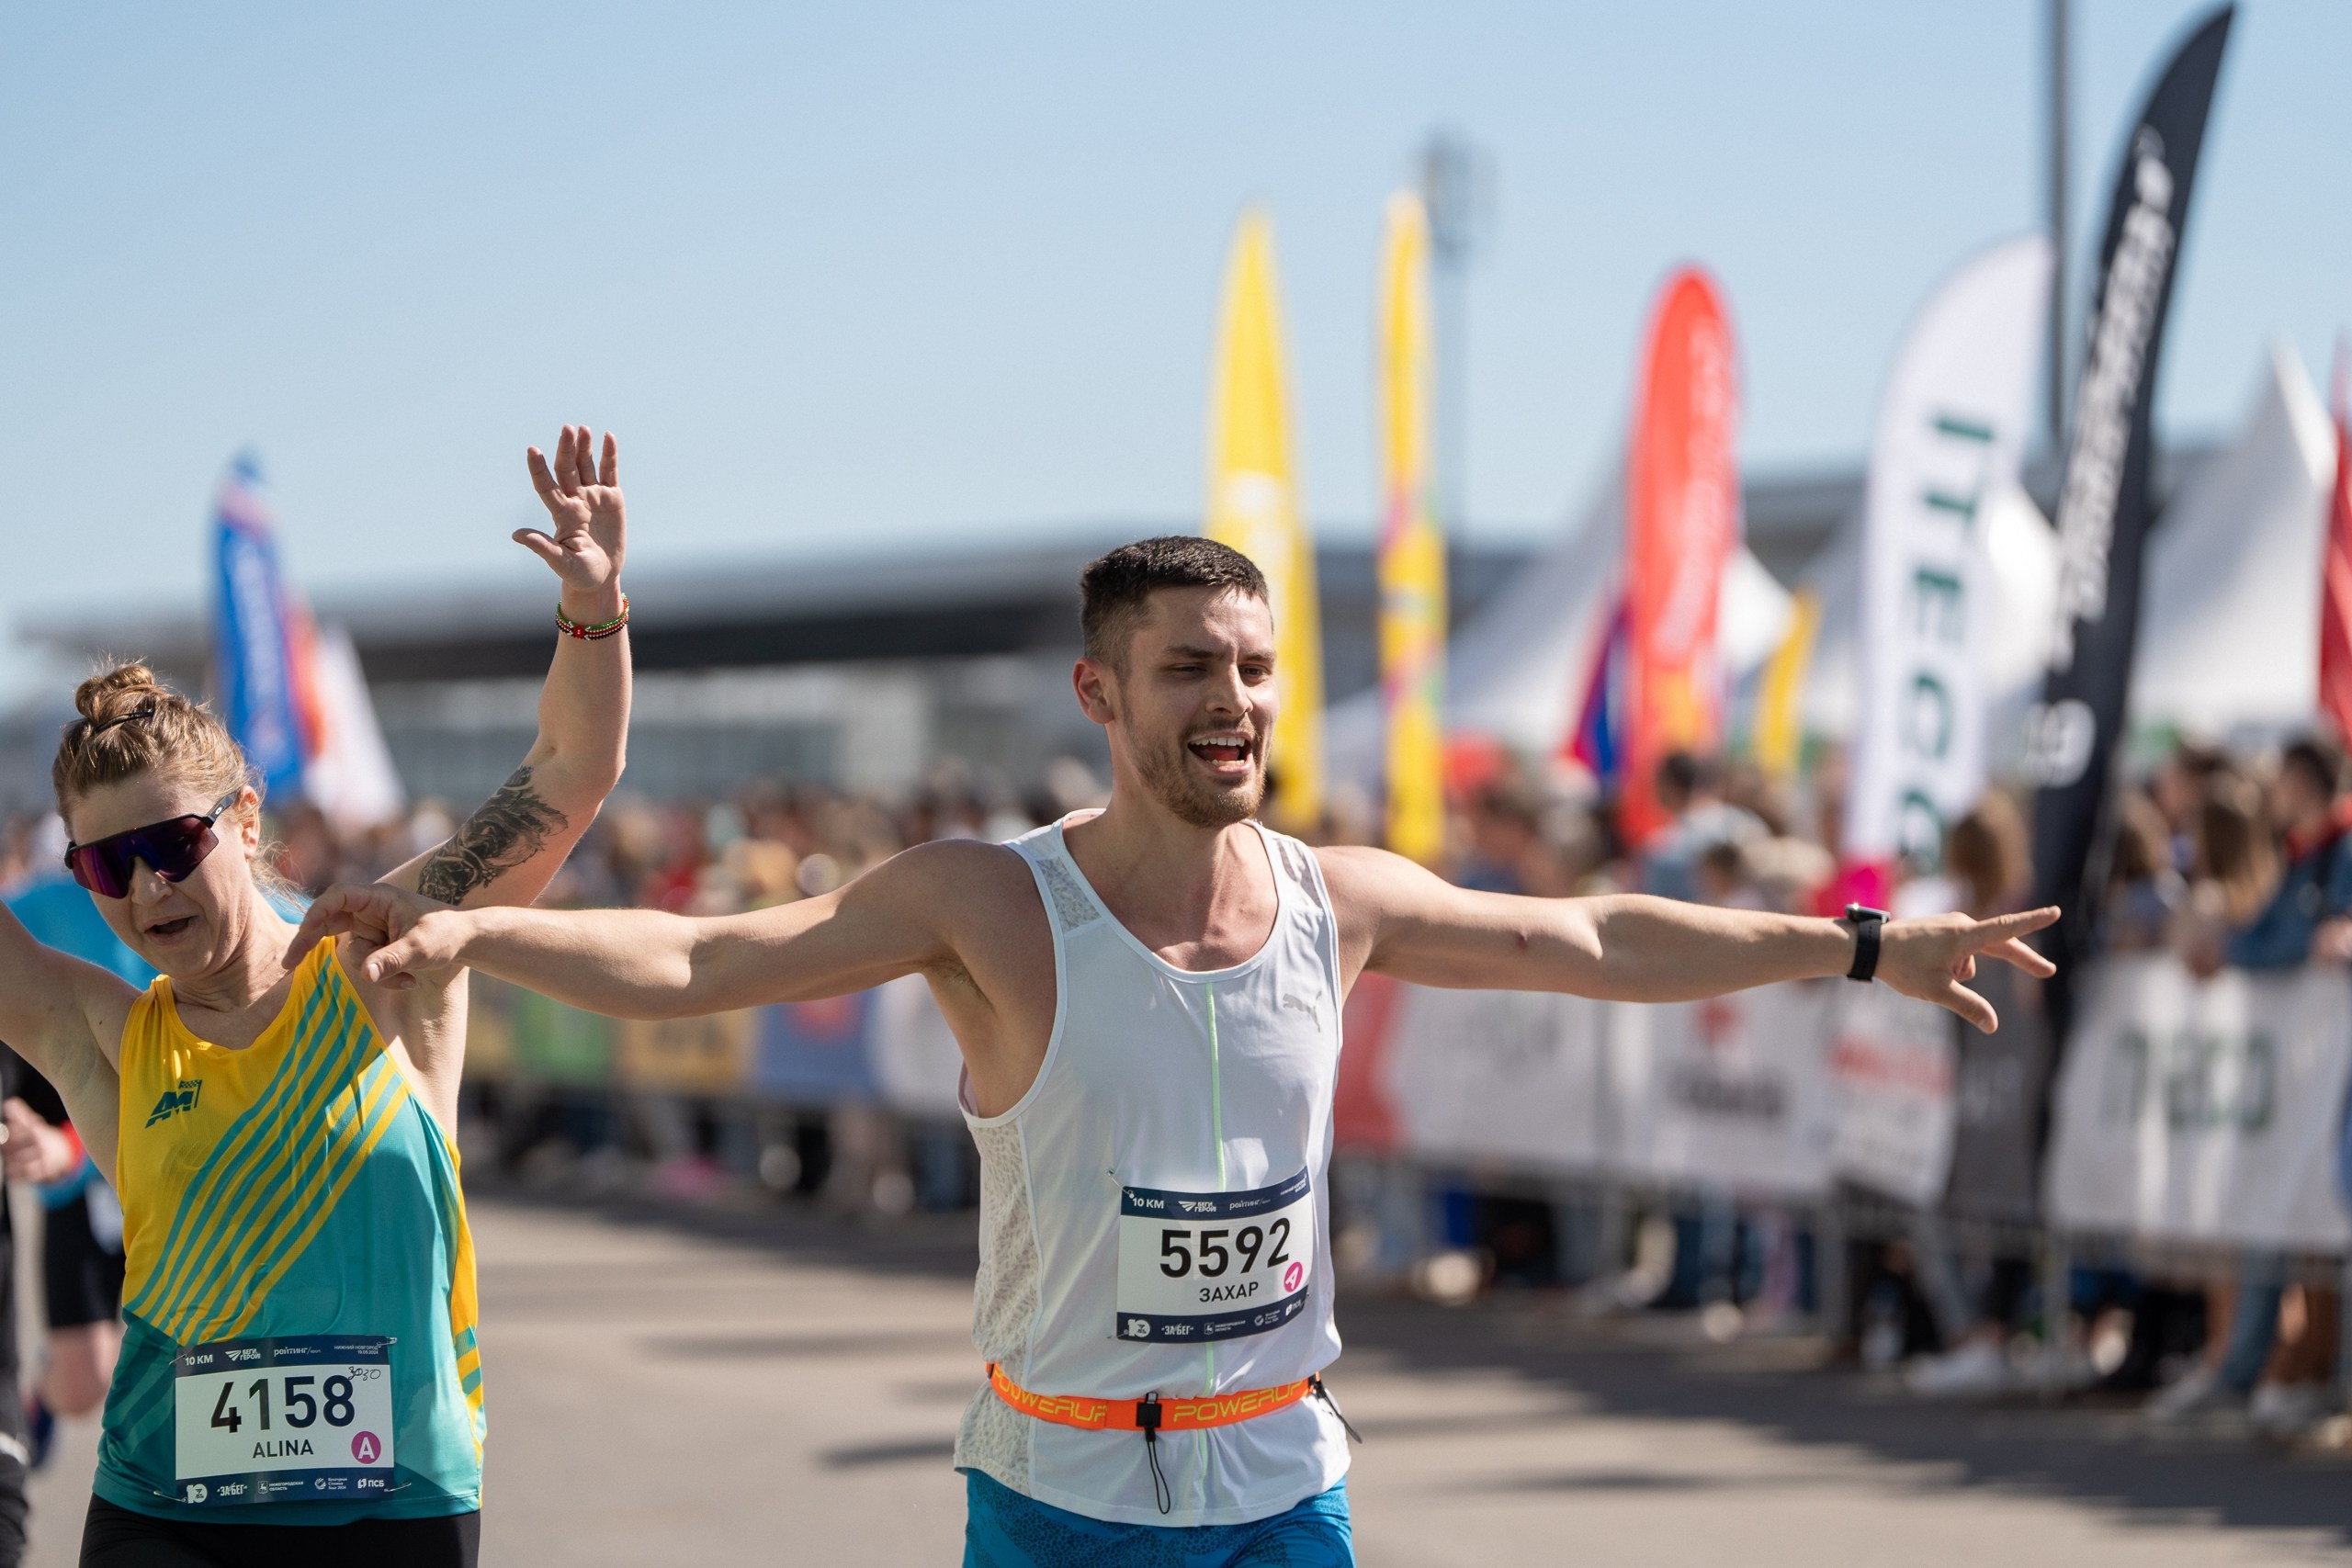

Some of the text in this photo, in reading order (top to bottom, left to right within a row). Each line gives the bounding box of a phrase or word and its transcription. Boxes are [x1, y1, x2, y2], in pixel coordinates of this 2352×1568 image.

[1132, 1198, 1145, 1207] 10
[1159, 1217, 1291, 1278] 5592
[1199, 1281, 1259, 1303] ЗАХАР
[185, 1357, 196, 1366] 10
[210, 1375, 356, 1433] 4158
[252, 1439, 314, 1459] ALINA
